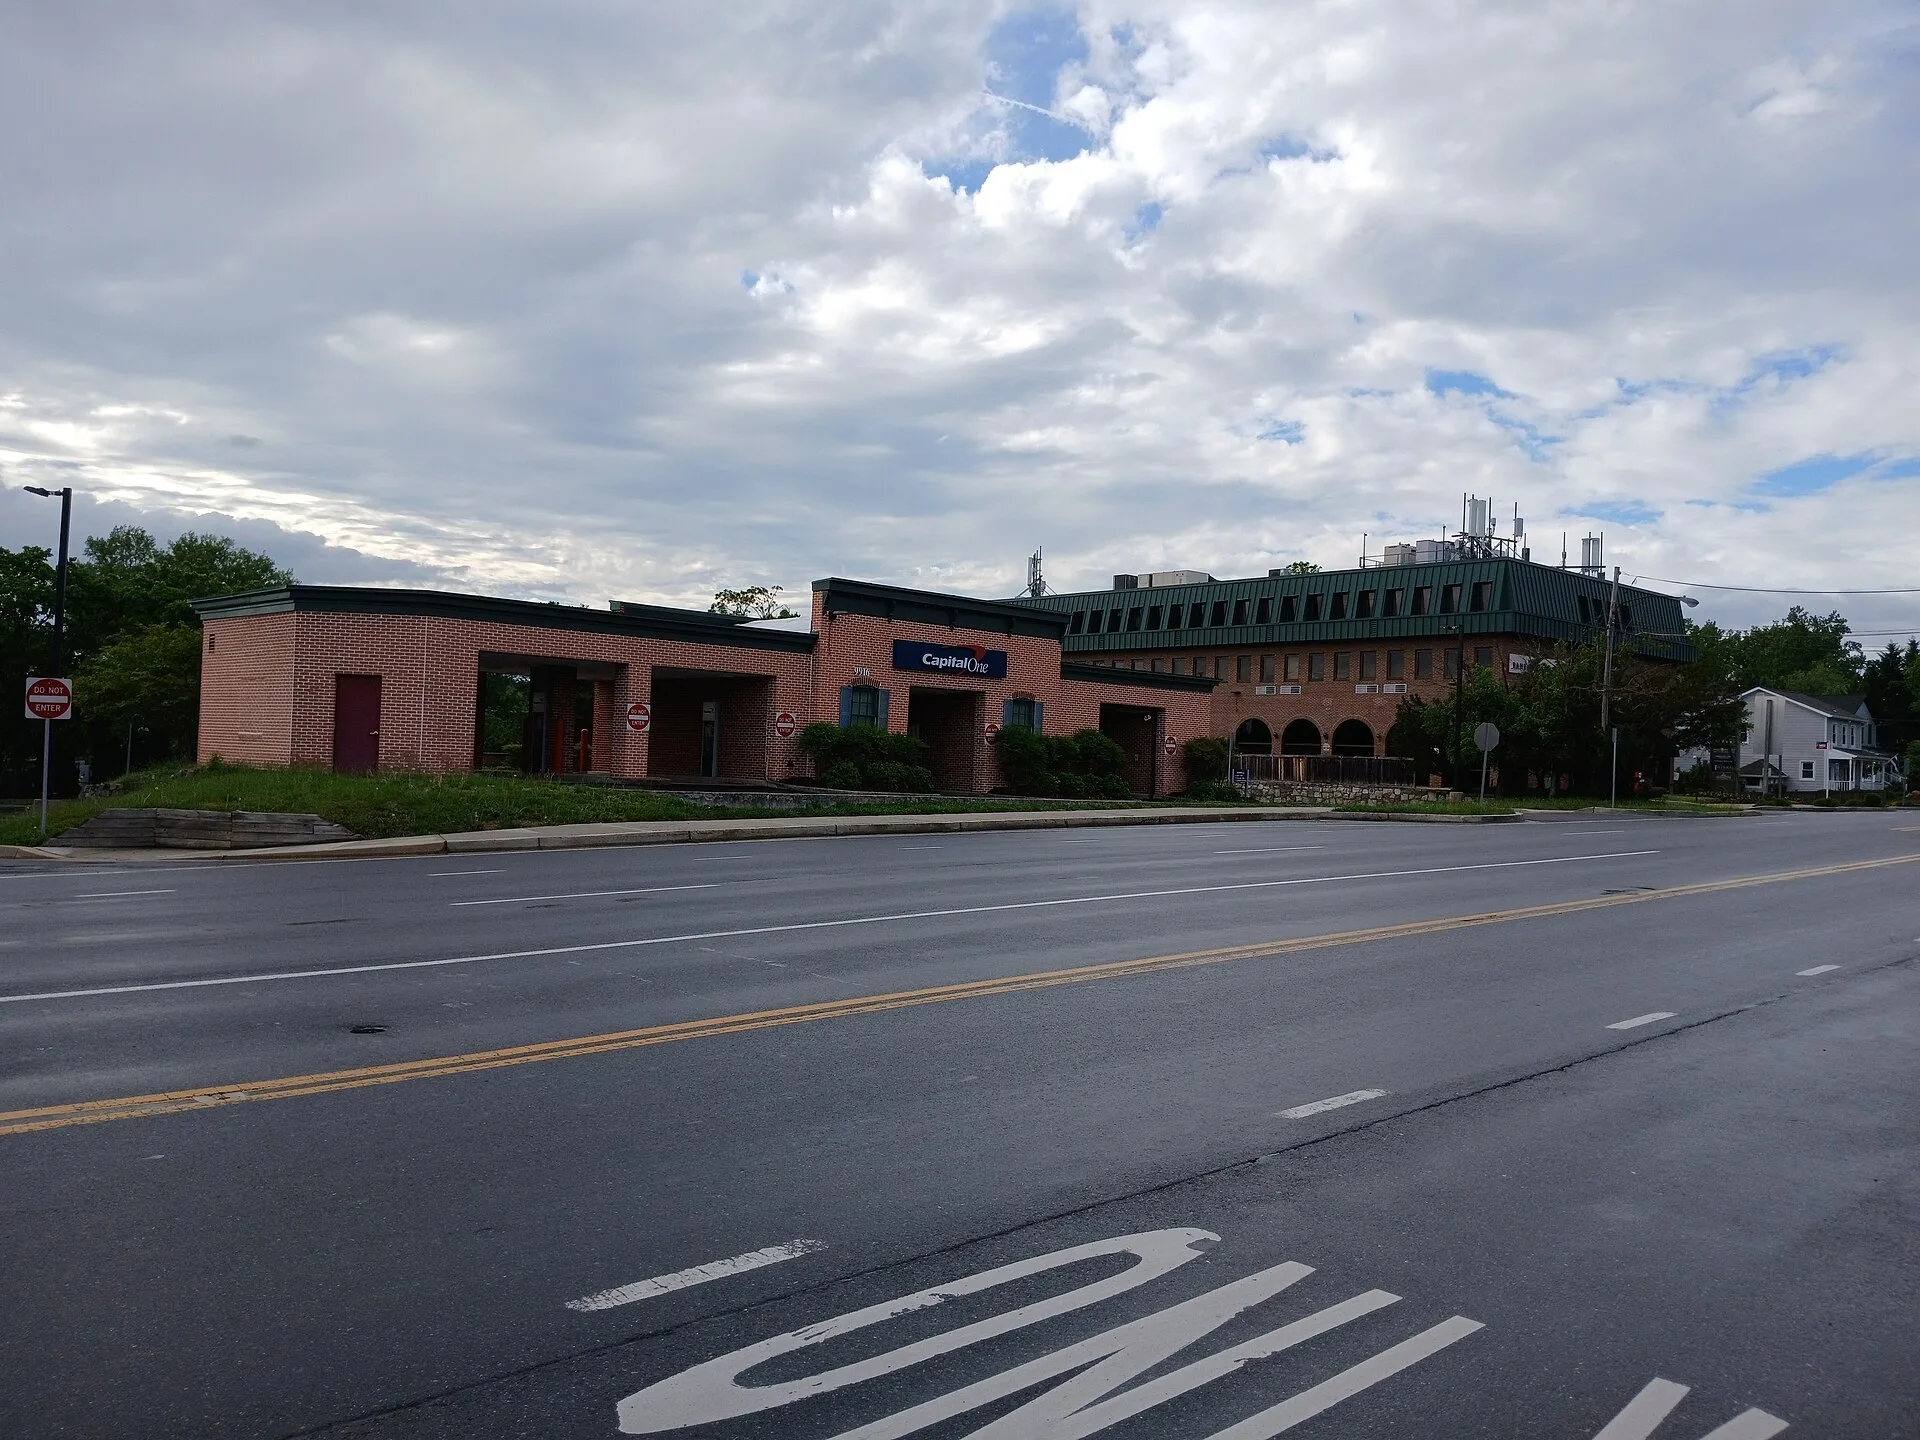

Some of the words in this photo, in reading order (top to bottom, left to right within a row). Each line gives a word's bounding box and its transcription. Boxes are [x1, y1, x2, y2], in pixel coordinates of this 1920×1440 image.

[34, 686, 46, 694] DO
[48, 686, 64, 694] NOT
[35, 704, 61, 712] ENTER
[616, 1228, 1791, 1440] ON
